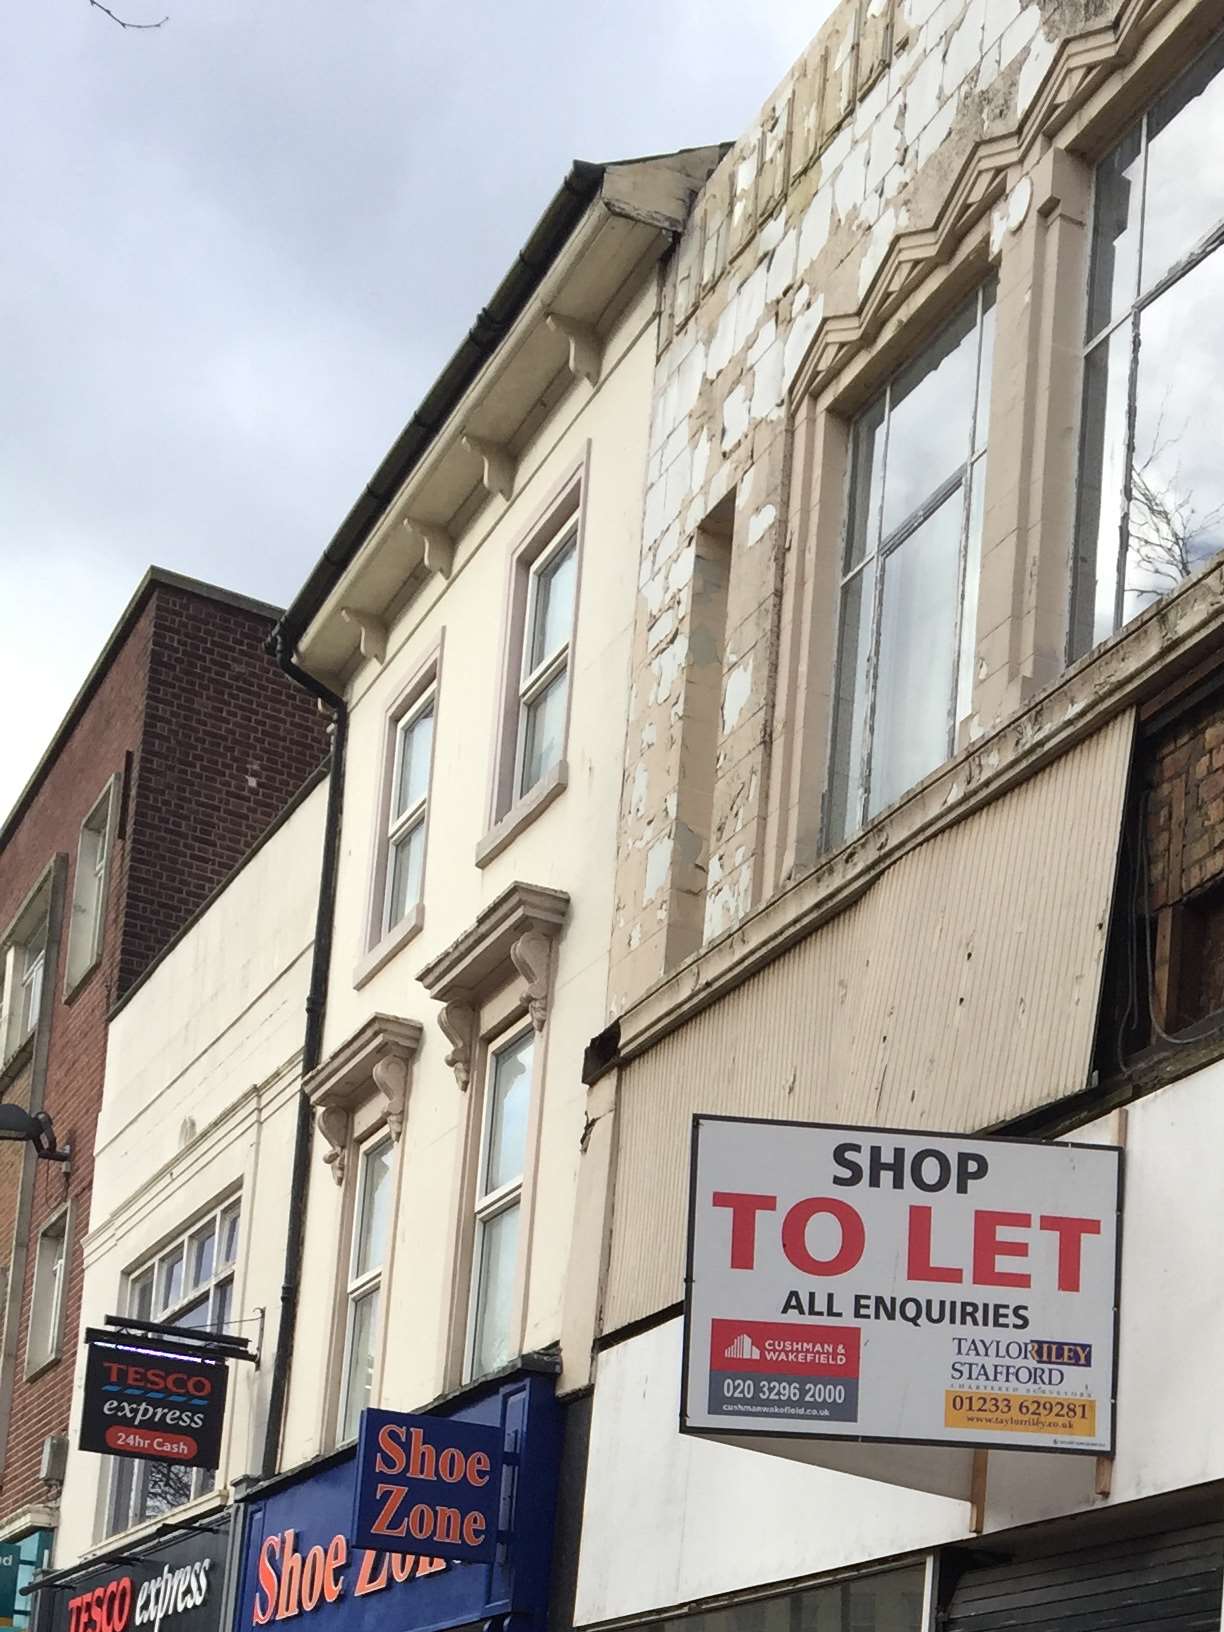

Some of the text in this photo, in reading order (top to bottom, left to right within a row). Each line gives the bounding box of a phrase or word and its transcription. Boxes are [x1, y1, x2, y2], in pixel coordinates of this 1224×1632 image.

[832, 1142, 989, 1194] SHOP
[712, 1191, 1102, 1293] TO LET
[781, 1290, 1031, 1329] ALL ENQUIRIES
[765, 1340, 846, 1354] CUSHMAN &
[765, 1351, 846, 1365] WAKEFIELD
[103, 1361, 212, 1397] TESCO
[951, 1361, 1065, 1386] STAFFORD
[723, 1378, 845, 1404] 020 3296 2000
[103, 1399, 204, 1428] express
[722, 1404, 830, 1416] cushmanwakefield.co.uk
[952, 1395, 1088, 1420] 01233 629281
[117, 1432, 188, 1454] 24hr Cash
[375, 1424, 491, 1487] Shoe
[371, 1483, 486, 1546] Zone
[252, 1528, 347, 1626] Shoe
